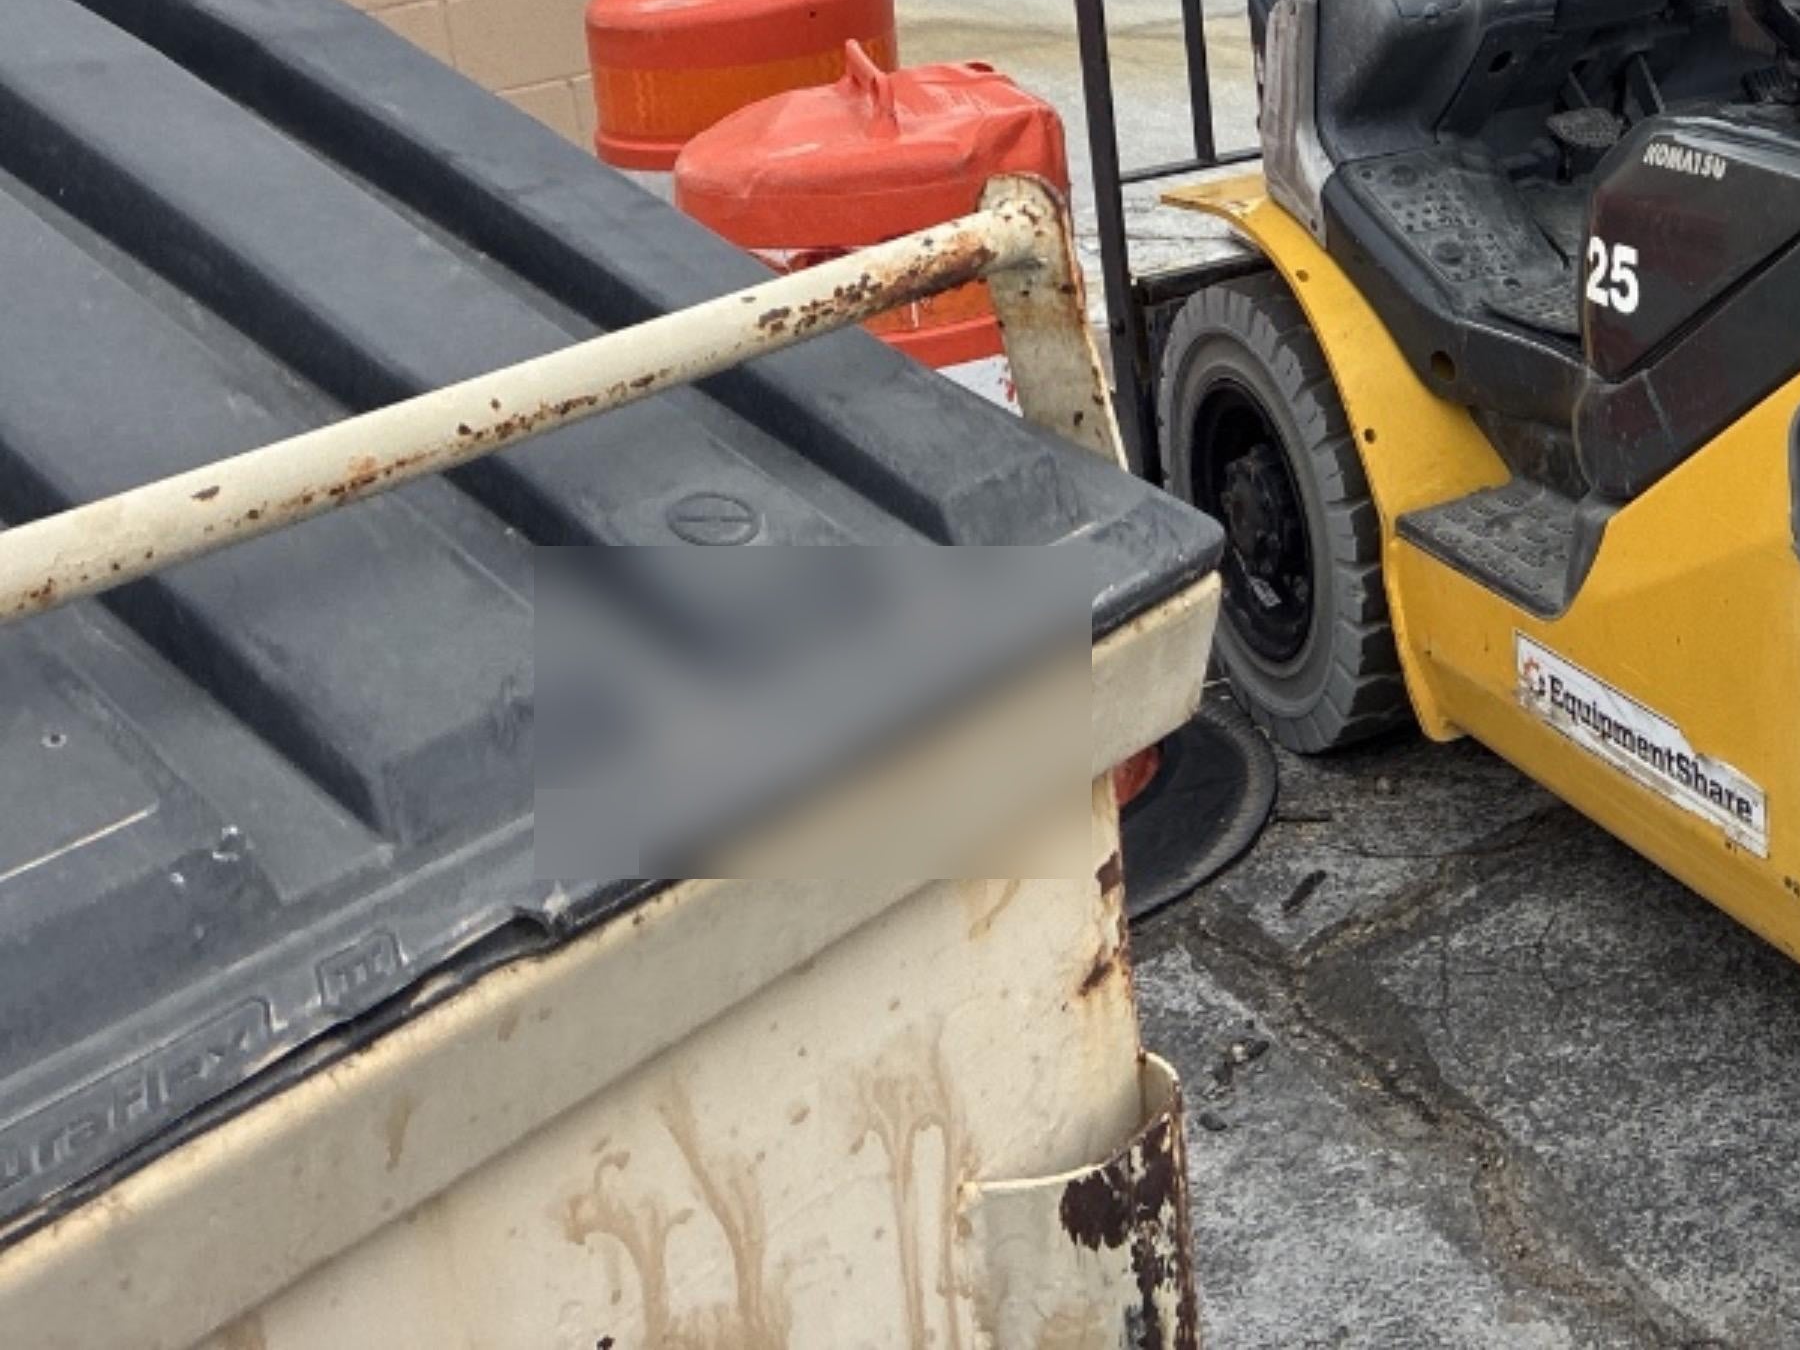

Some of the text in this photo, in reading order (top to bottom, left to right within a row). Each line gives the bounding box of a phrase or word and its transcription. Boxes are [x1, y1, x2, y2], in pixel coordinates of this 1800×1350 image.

[1643, 143, 1727, 181] KOMATSU
[1586, 235, 1640, 317] 25
[1549, 674, 1754, 823] EquipmentShare
